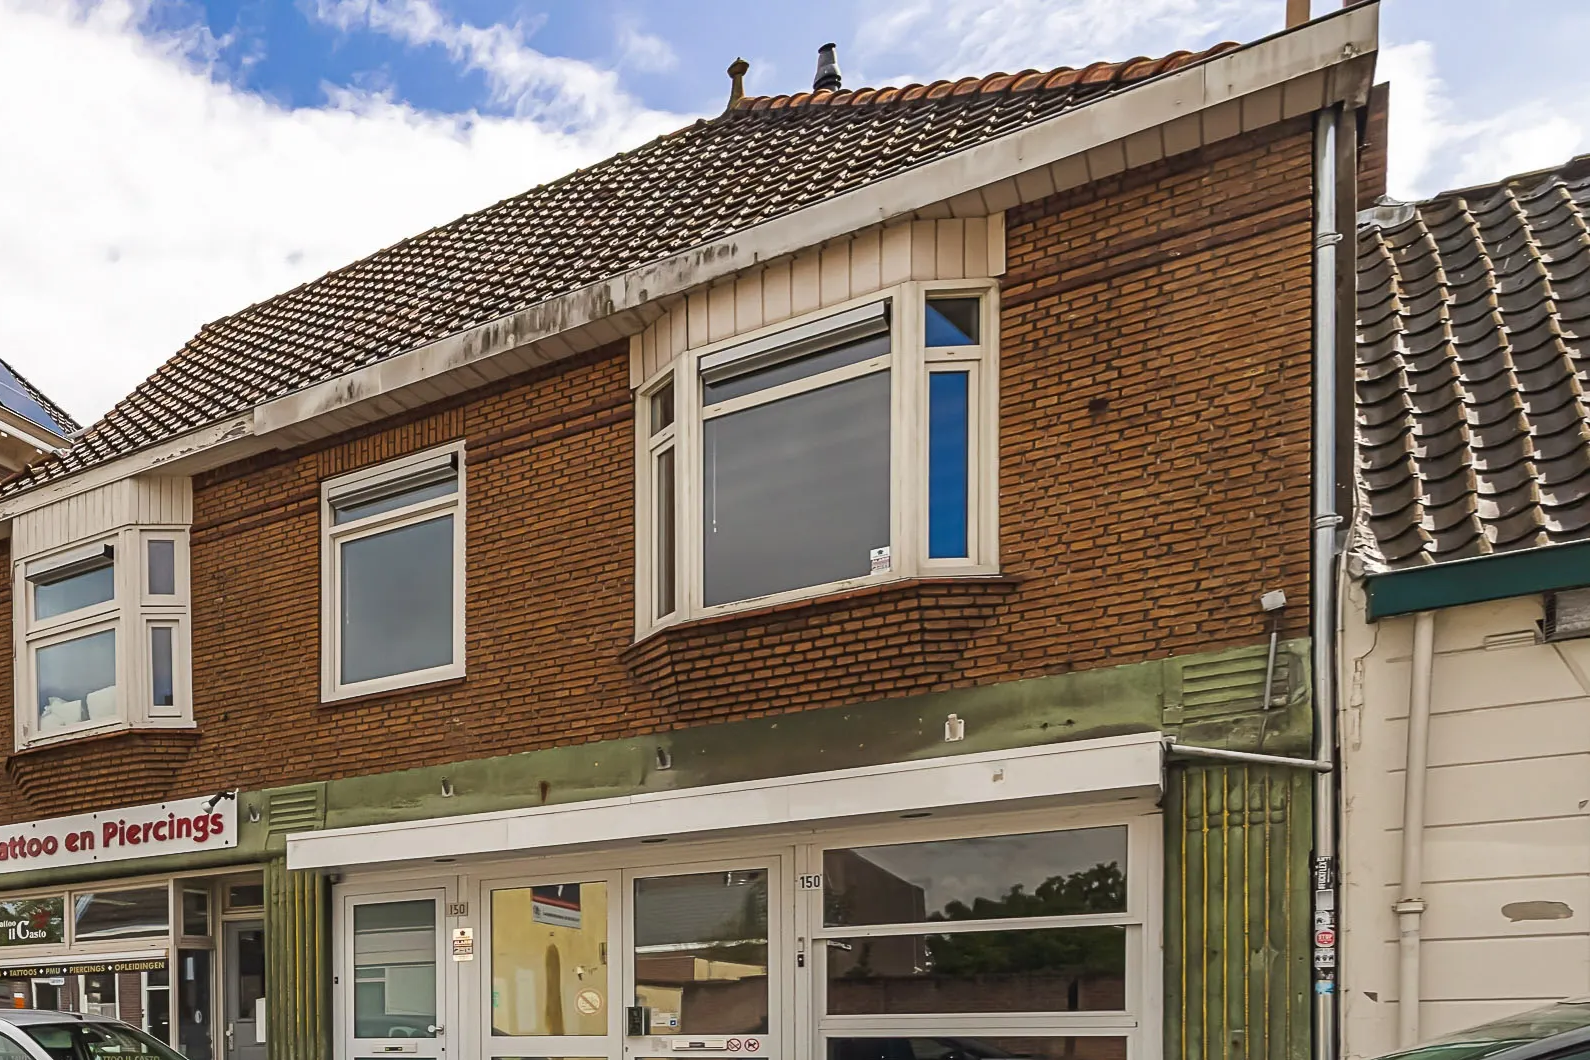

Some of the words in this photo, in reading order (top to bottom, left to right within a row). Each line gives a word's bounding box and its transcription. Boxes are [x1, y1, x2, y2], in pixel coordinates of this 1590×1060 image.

[65, 827, 95, 852] en
[102, 812, 224, 848] Piercings
[799, 875, 821, 889] 150
[449, 904, 465, 915] 150
[16, 920, 47, 940] Casto
[9, 968, 37, 977] TATTOOS
[45, 966, 61, 975] PMU
[69, 964, 106, 973] PIERCINGS
[114, 961, 165, 971] OPLEIDINGEN
